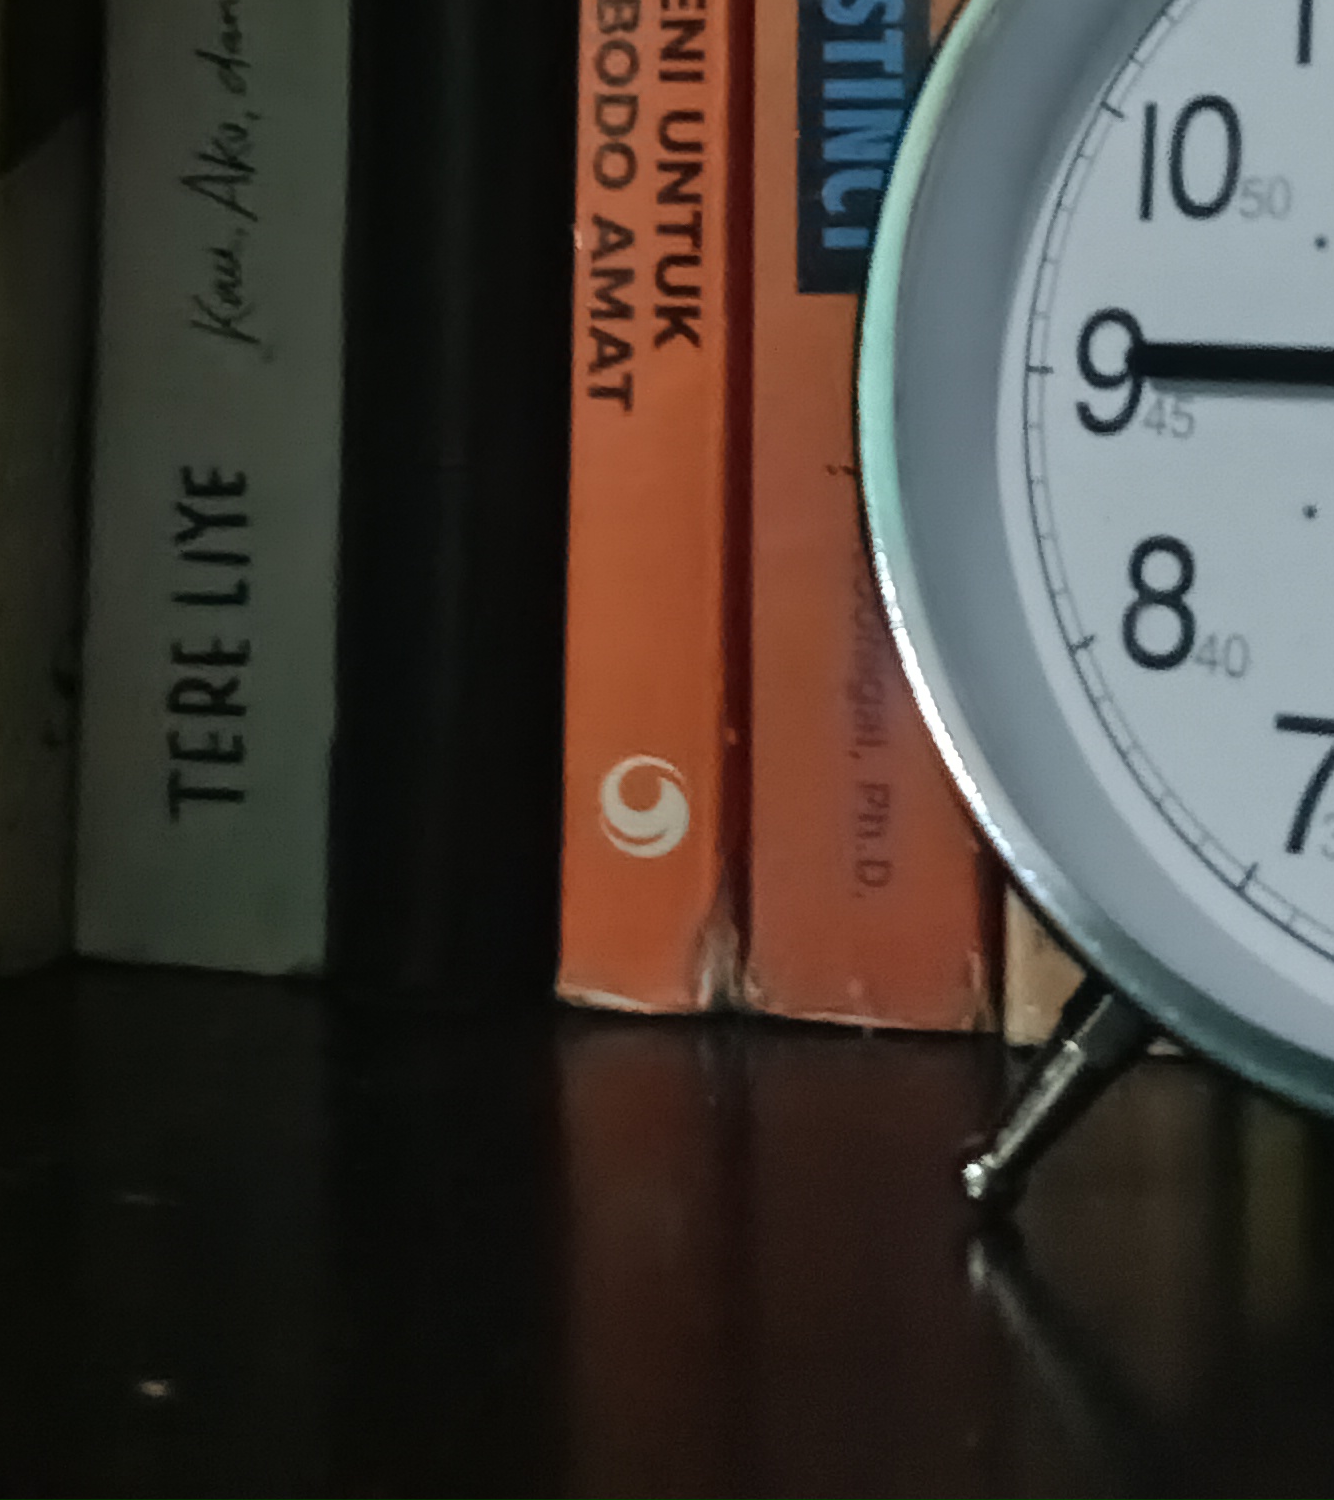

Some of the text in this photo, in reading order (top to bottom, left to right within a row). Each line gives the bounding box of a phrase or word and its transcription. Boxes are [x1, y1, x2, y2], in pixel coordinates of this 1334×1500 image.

[1139, 94, 1243, 222] 10
[1238, 176, 1294, 221] 50
[654, 111, 704, 348] UNTUK
[587, 213, 636, 414] AMAT
[1076, 307, 1145, 437] 9
[1141, 402, 1196, 440] 45
[167, 464, 252, 824] TERE LIYE
[1122, 534, 1196, 671] 8
[1193, 633, 1251, 680] 40
